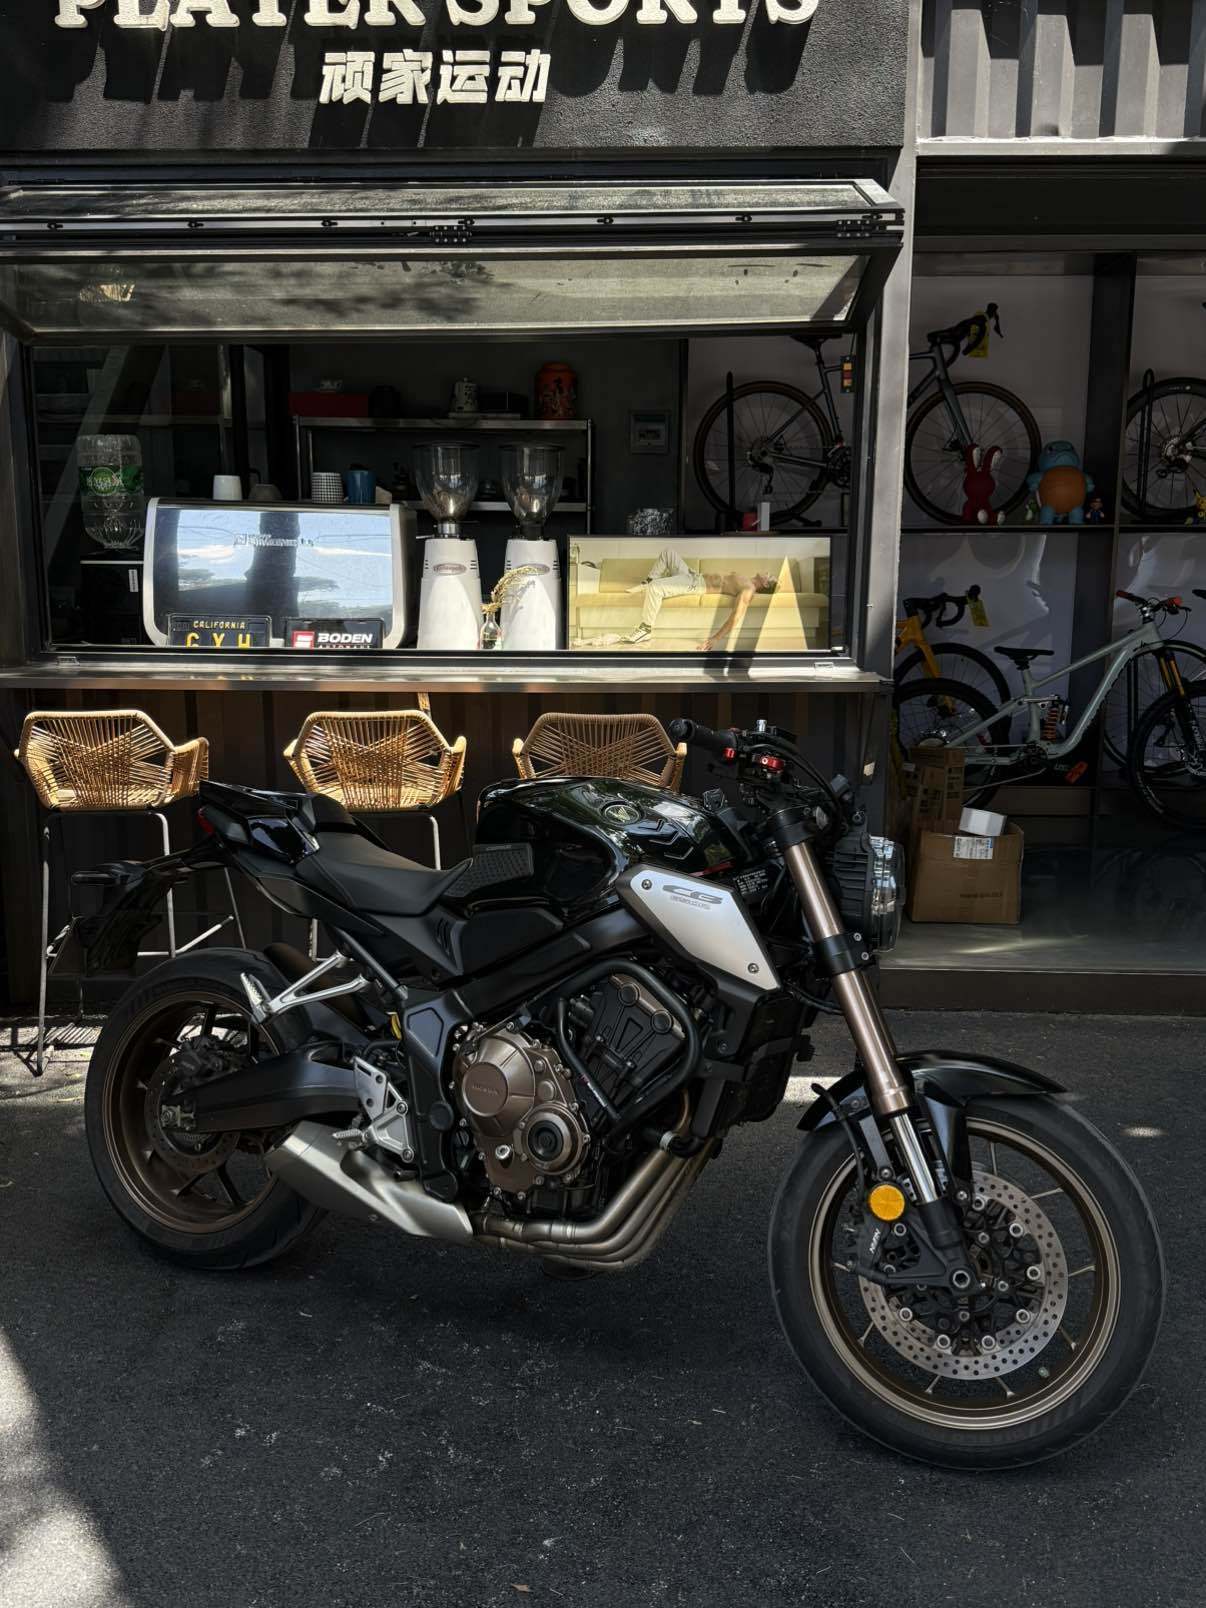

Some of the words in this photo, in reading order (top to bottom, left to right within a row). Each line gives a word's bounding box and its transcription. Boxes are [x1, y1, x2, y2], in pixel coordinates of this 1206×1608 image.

[319, 49, 551, 104] 顽家运动
[193, 620, 246, 630] CALIFORNIA
[317, 632, 373, 644] BODEN
